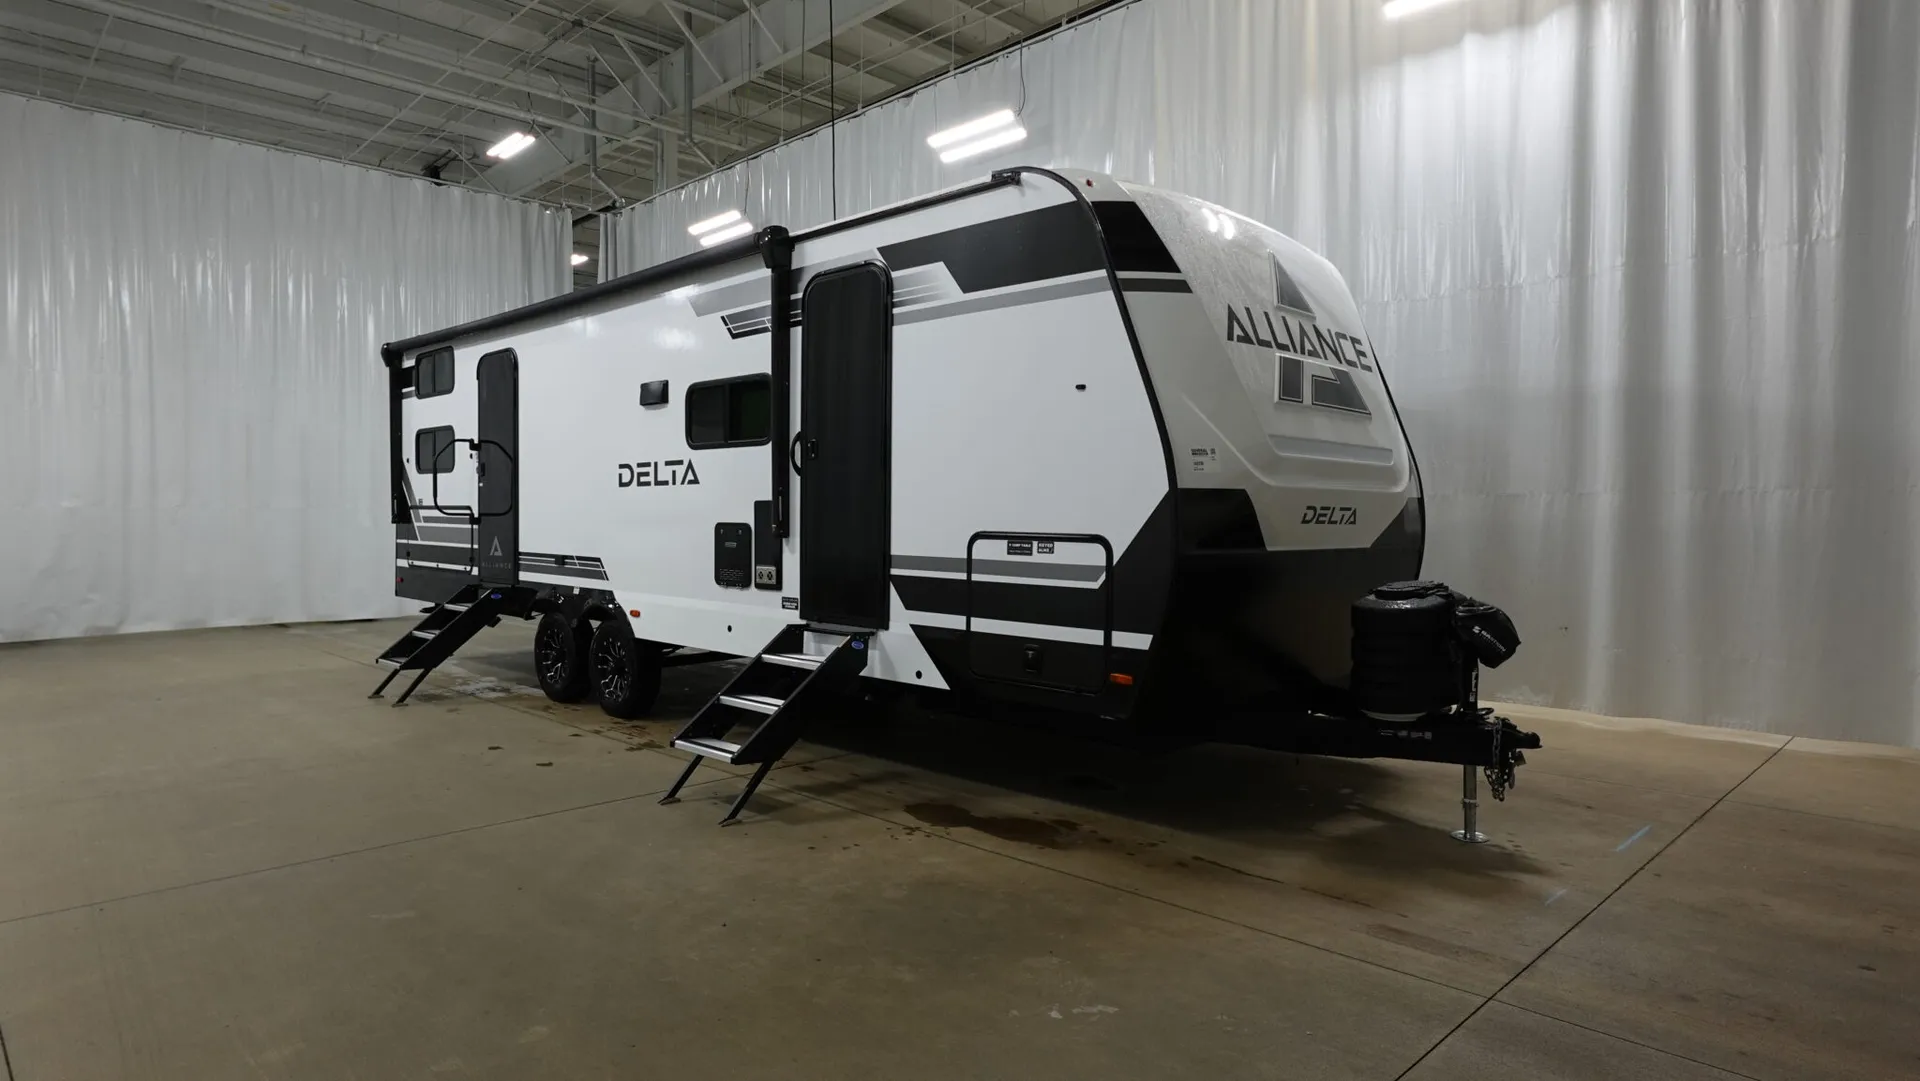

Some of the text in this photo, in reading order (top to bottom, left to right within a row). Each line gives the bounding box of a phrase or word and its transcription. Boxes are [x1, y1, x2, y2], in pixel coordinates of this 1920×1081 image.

[1226, 302, 1374, 374] ALLIANCE
[617, 457, 701, 489] DELTA
[1300, 504, 1357, 526] DELTA
